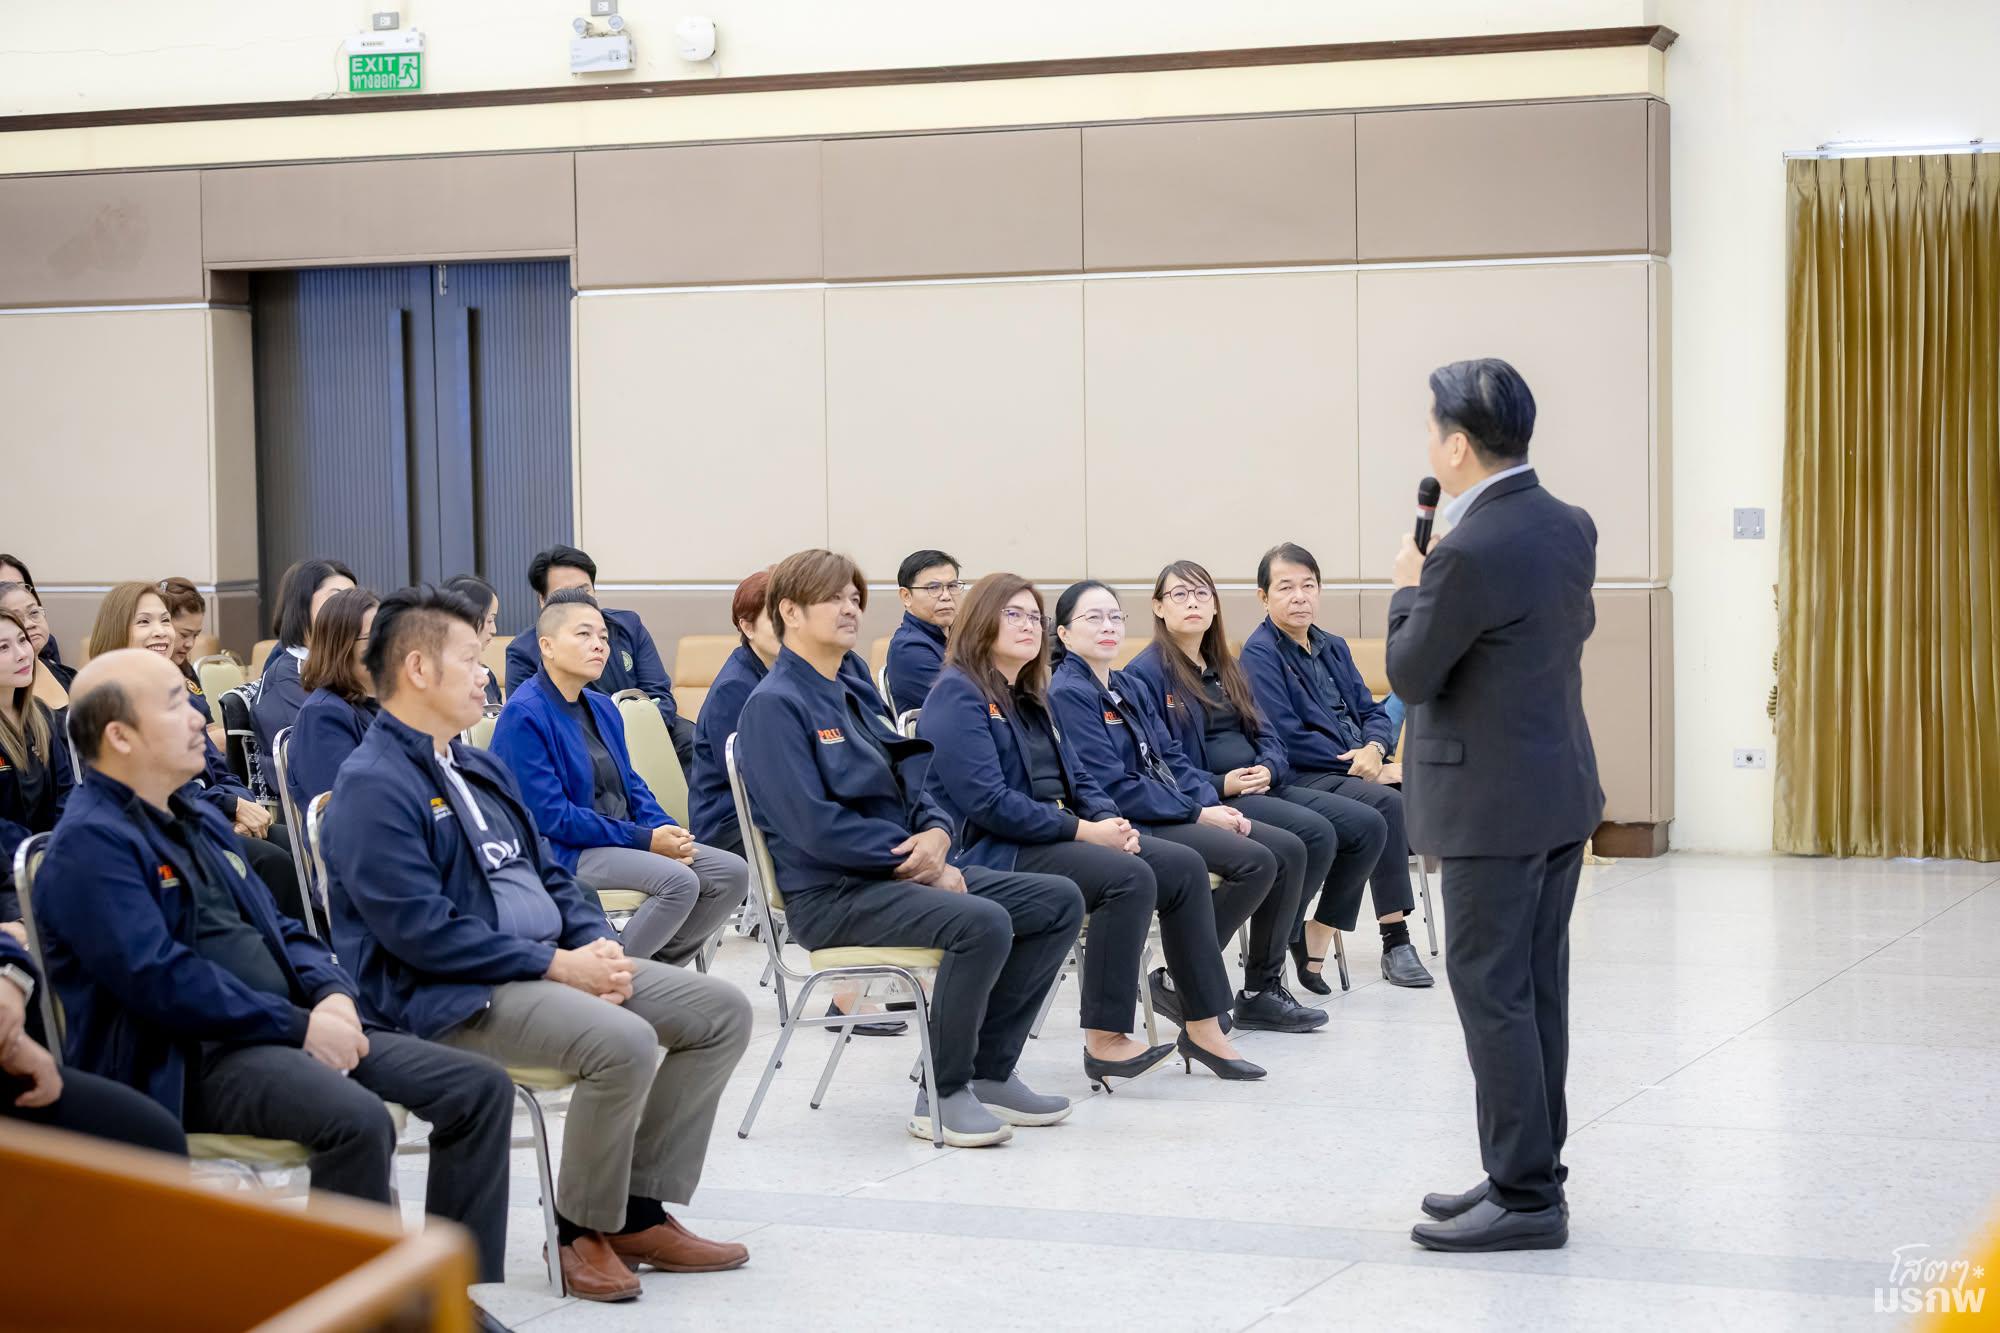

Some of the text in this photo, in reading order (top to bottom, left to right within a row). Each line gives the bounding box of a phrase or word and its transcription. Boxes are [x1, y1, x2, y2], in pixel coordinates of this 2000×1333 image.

[351, 56, 396, 73] EXIT
[352, 73, 397, 89] ทางออก
